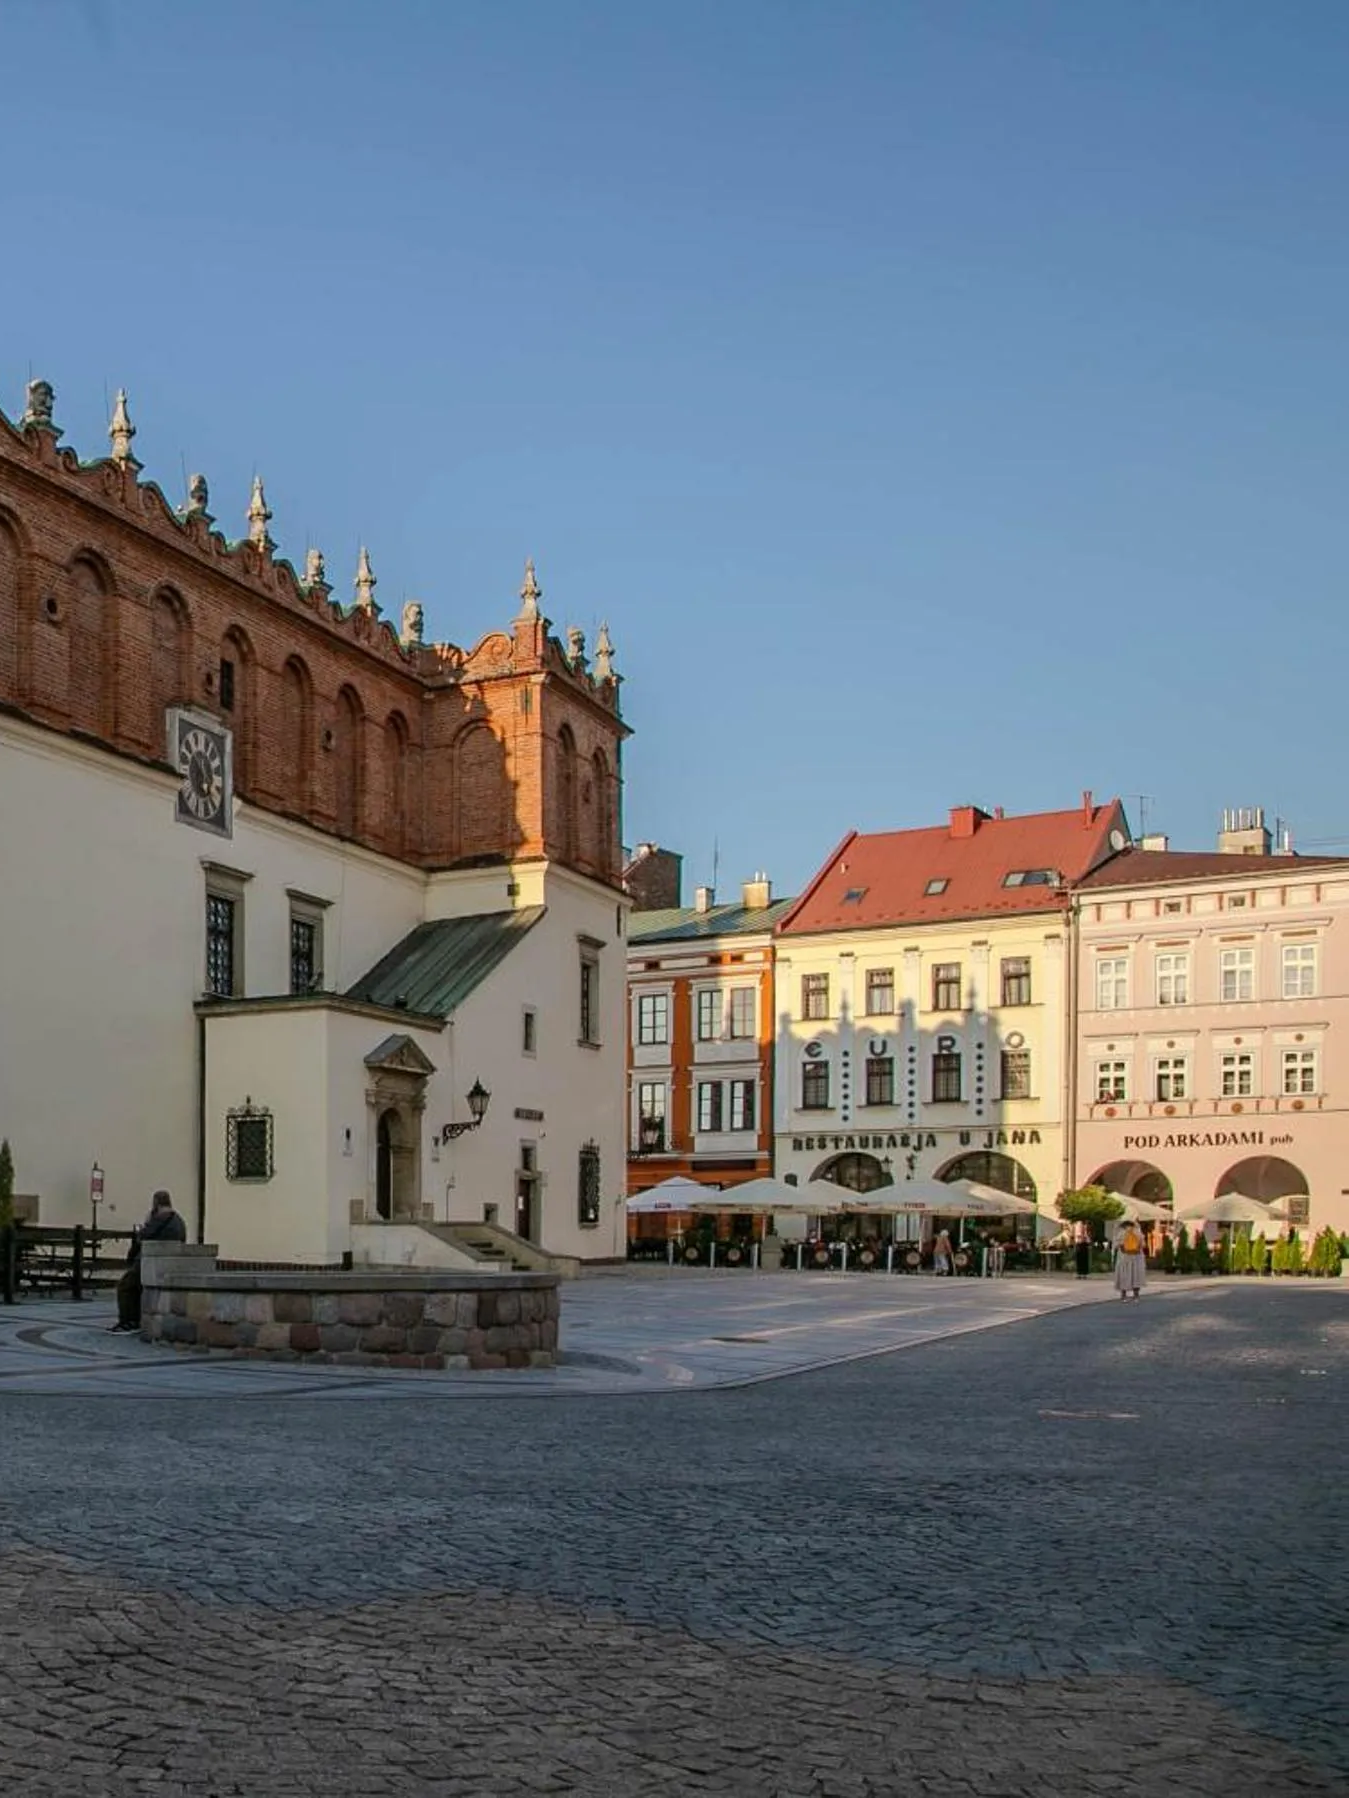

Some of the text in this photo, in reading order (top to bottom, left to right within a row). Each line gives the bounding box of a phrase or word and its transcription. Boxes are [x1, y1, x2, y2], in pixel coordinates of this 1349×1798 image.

[983, 1129, 1042, 1149] JANA
[1124, 1131, 1294, 1149] POD ARKADAMI pub
